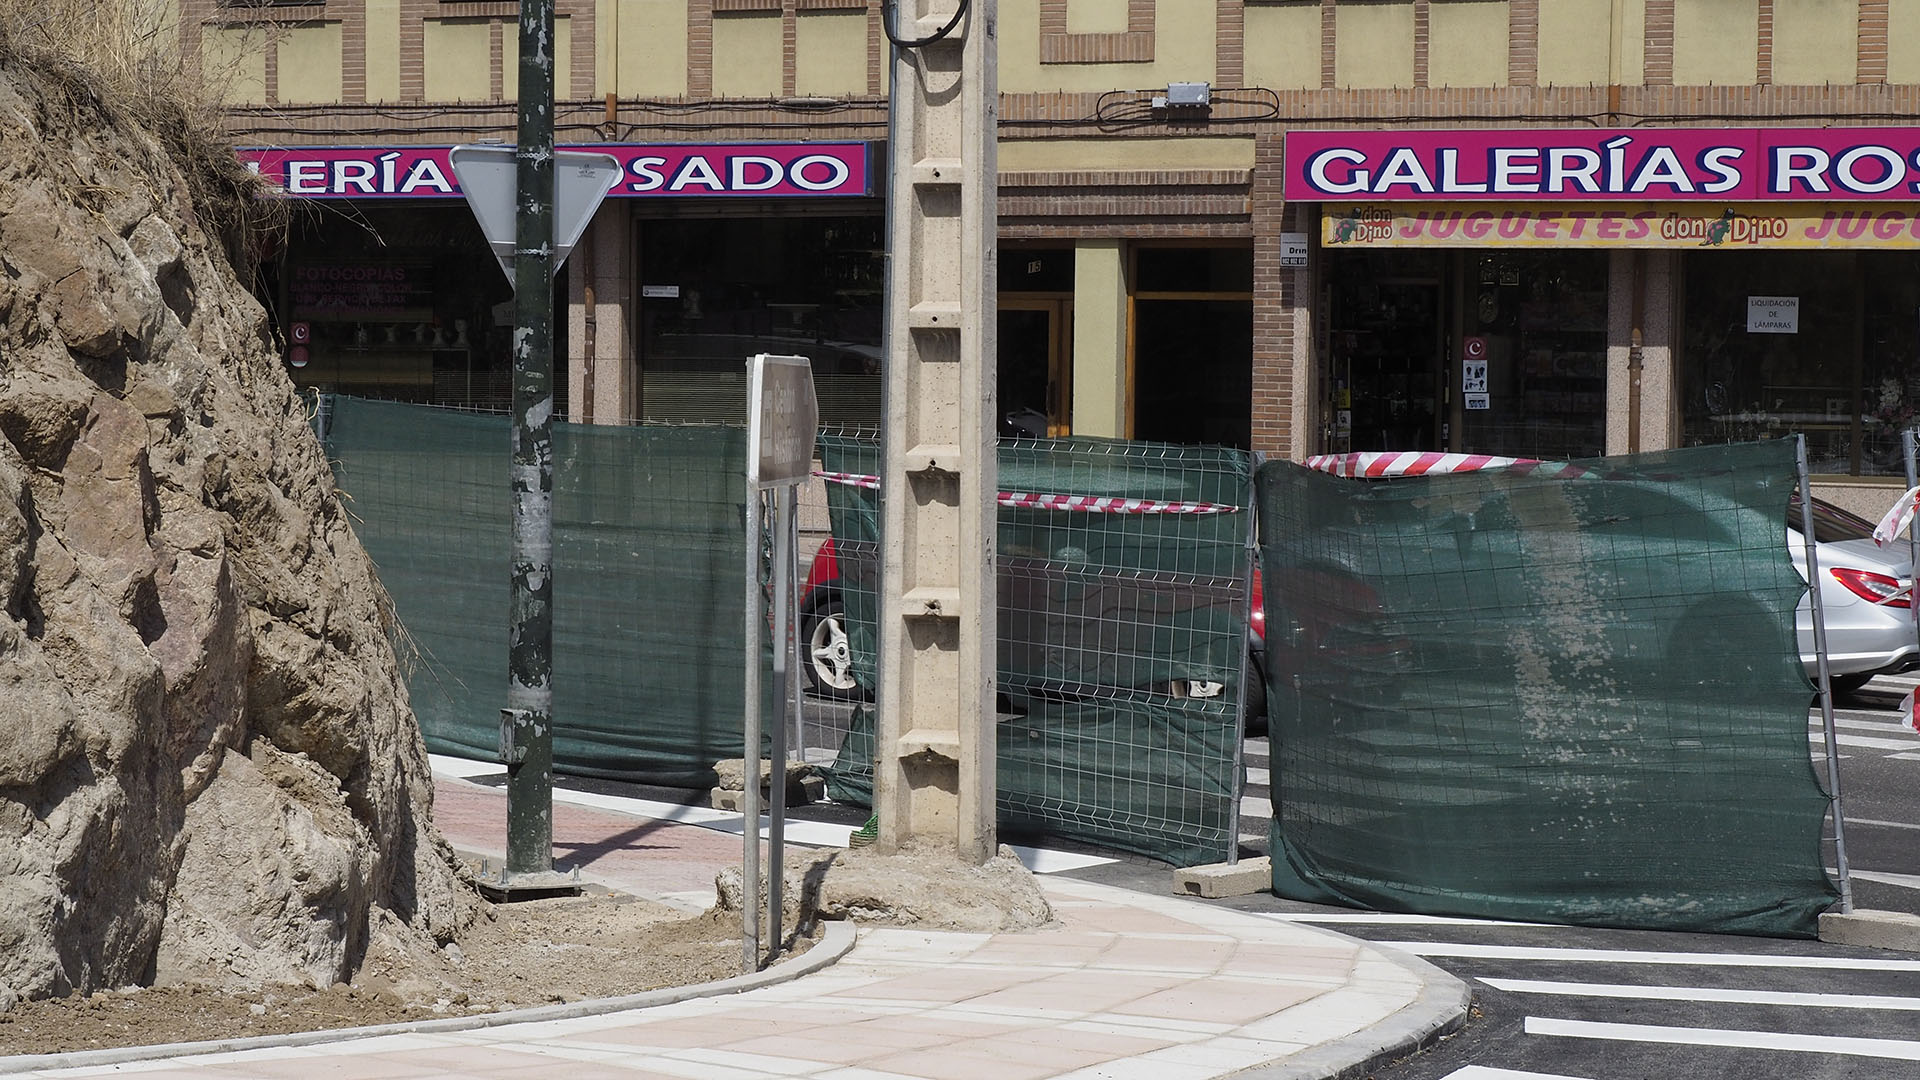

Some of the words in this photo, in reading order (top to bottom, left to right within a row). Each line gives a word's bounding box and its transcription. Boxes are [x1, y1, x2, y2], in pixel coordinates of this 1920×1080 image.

[610, 154, 850, 192] SADO
[1304, 135, 1745, 194] GALERÍAS
[1768, 144, 1920, 194] RO
[1362, 206, 1391, 223] don
[1355, 222, 1392, 243] Dino
[1399, 210, 1657, 240] JUGUETES
[1660, 212, 1706, 240] don
[1730, 214, 1788, 244] Dino
[296, 266, 405, 280] FOTOCOPIAS
[1028, 260, 1042, 274] 15
[1751, 299, 1796, 307] LIQUIDACIÓN
[1754, 321, 1792, 329] LÁMPARAS
